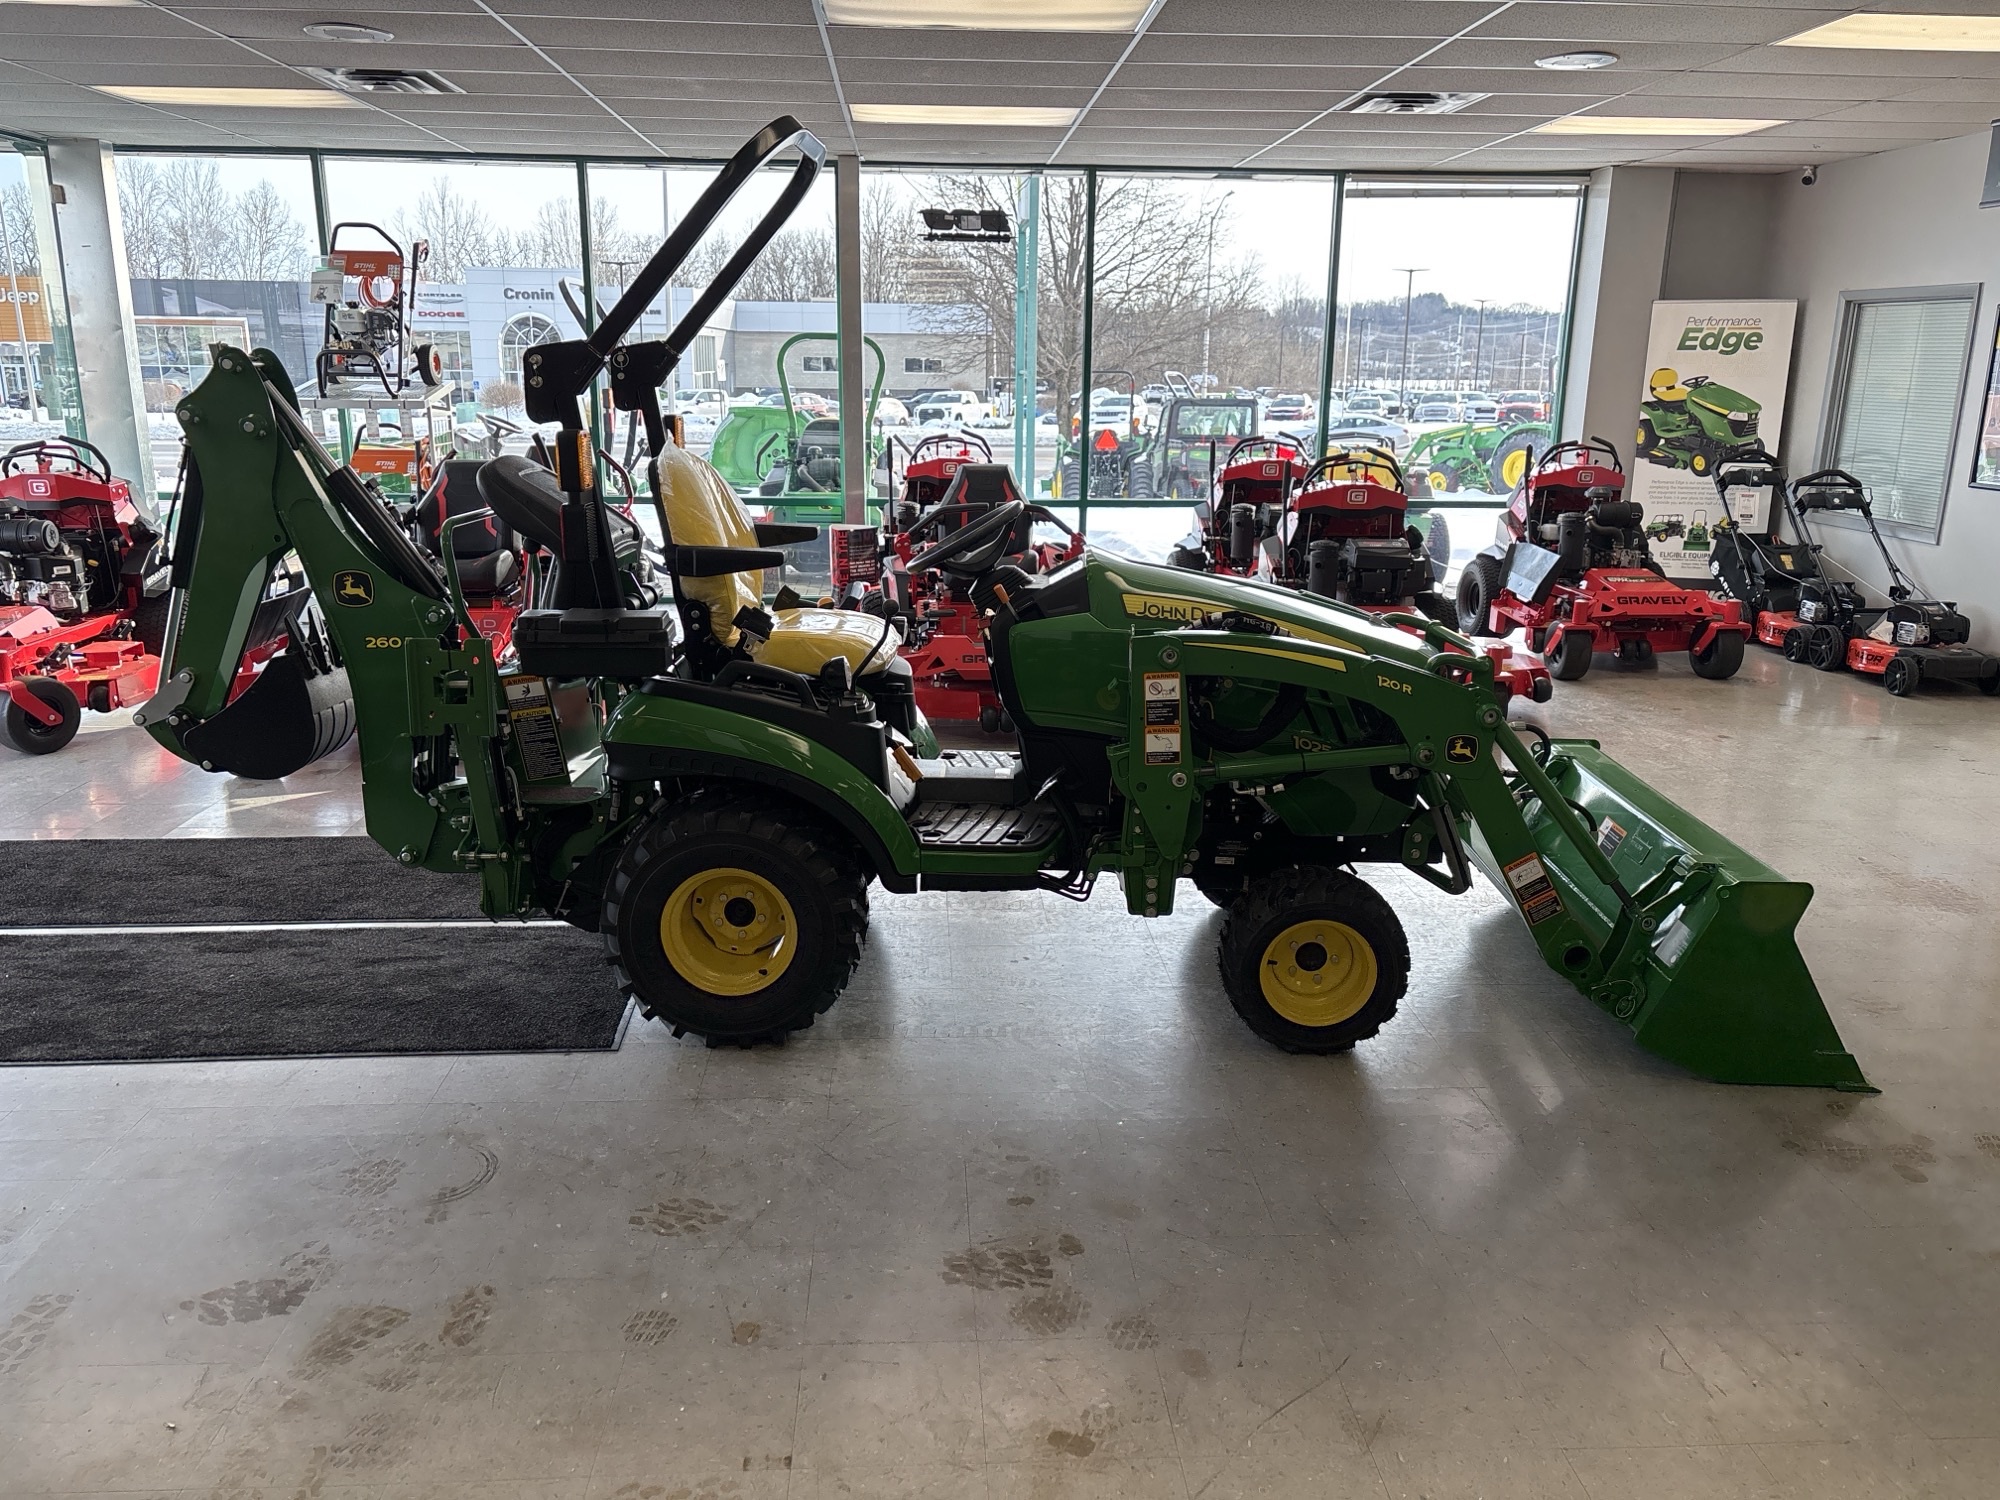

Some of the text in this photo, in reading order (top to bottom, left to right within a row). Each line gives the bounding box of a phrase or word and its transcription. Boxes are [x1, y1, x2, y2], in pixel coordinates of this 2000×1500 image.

[0, 288, 40, 305] Jeep
[504, 288, 555, 300] Cronin
[1686, 316, 1761, 326] Performance
[1676, 327, 1763, 355] Edge
[839, 530, 848, 554] THE
[146, 566, 170, 585] GRAVEL
[1617, 596, 1688, 605] GRAVELY
[1138, 601, 1186, 620] JOHN
[962, 654, 988, 663] GR
